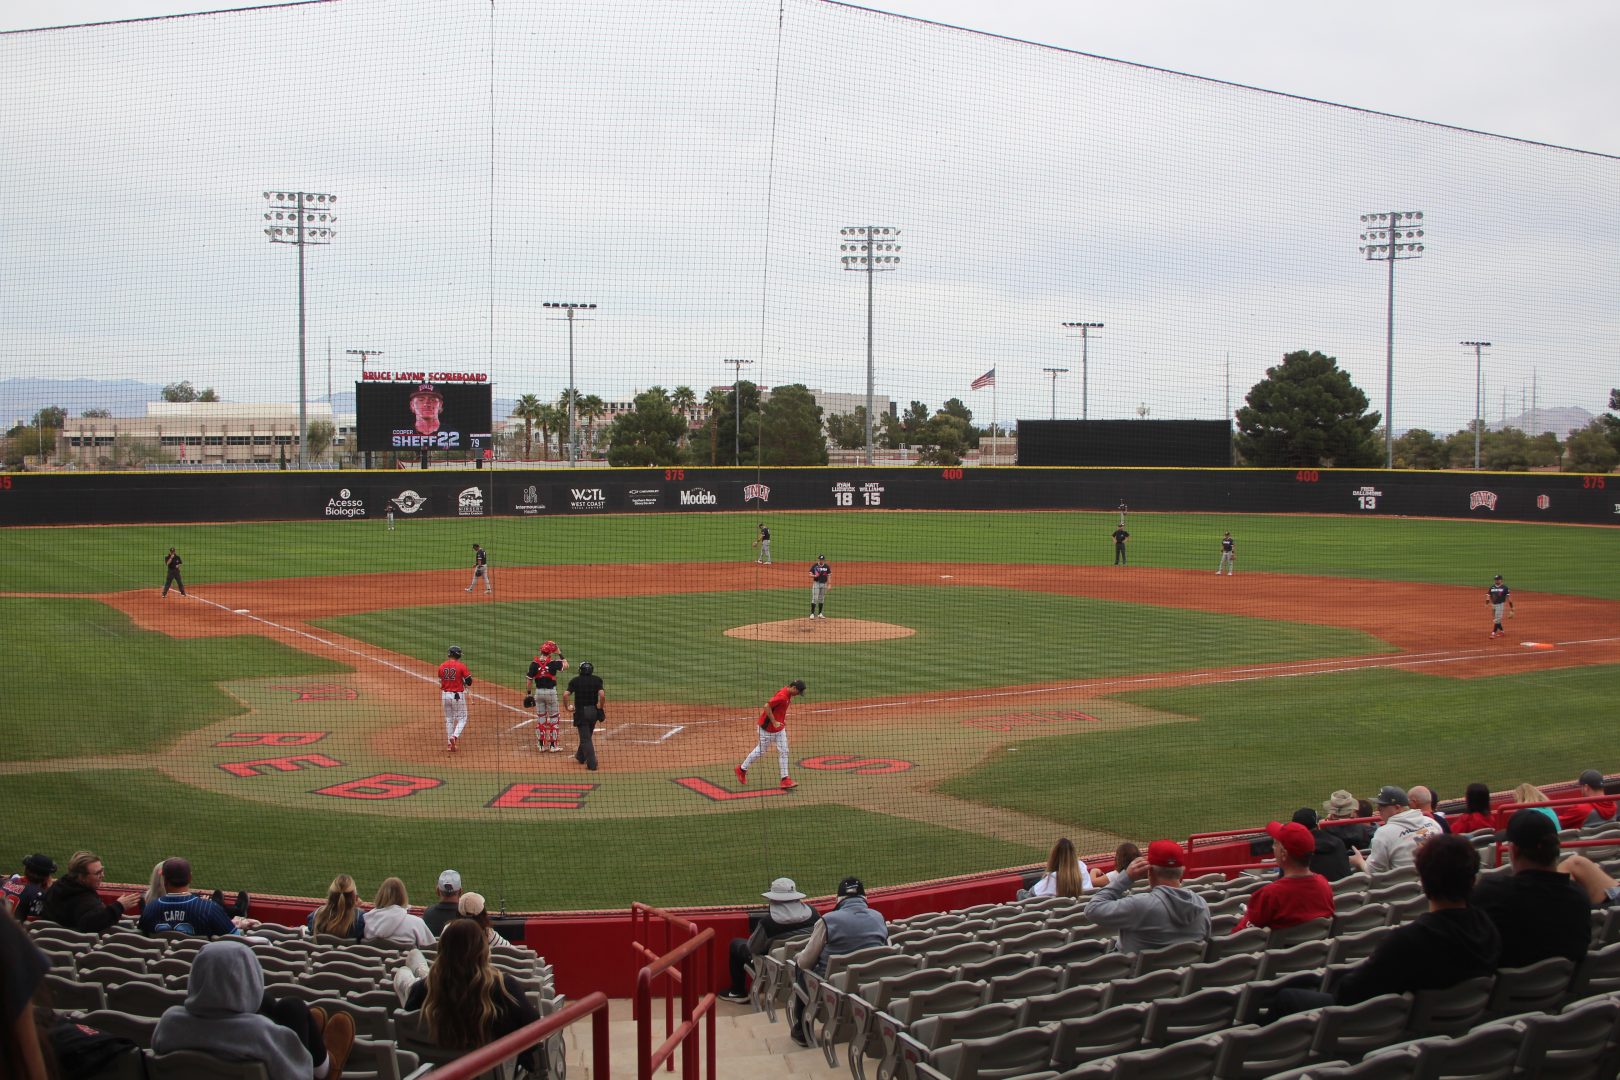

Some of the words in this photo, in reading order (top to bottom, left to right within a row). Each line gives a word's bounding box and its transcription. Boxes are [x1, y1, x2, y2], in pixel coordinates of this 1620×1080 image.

[362, 372, 391, 380] BRUCE
[428, 372, 488, 381] SCOREBOARD
[392, 436, 437, 446] SHEFF
[437, 432, 460, 447] 22
[470, 438, 480, 448] 79
[664, 470, 685, 481] 375
[942, 469, 963, 480] 400
[1296, 471, 1319, 482] 400
[1583, 476, 1605, 489] 375
[571, 488, 606, 501] WCTL
[680, 490, 717, 505] Modelo
[834, 493, 853, 506] 18
[863, 493, 881, 506] 15
[328, 498, 363, 507] Acesso
[1358, 496, 1376, 509] 13
[325, 507, 366, 517] Biologics
[442, 667, 457, 681] 22
